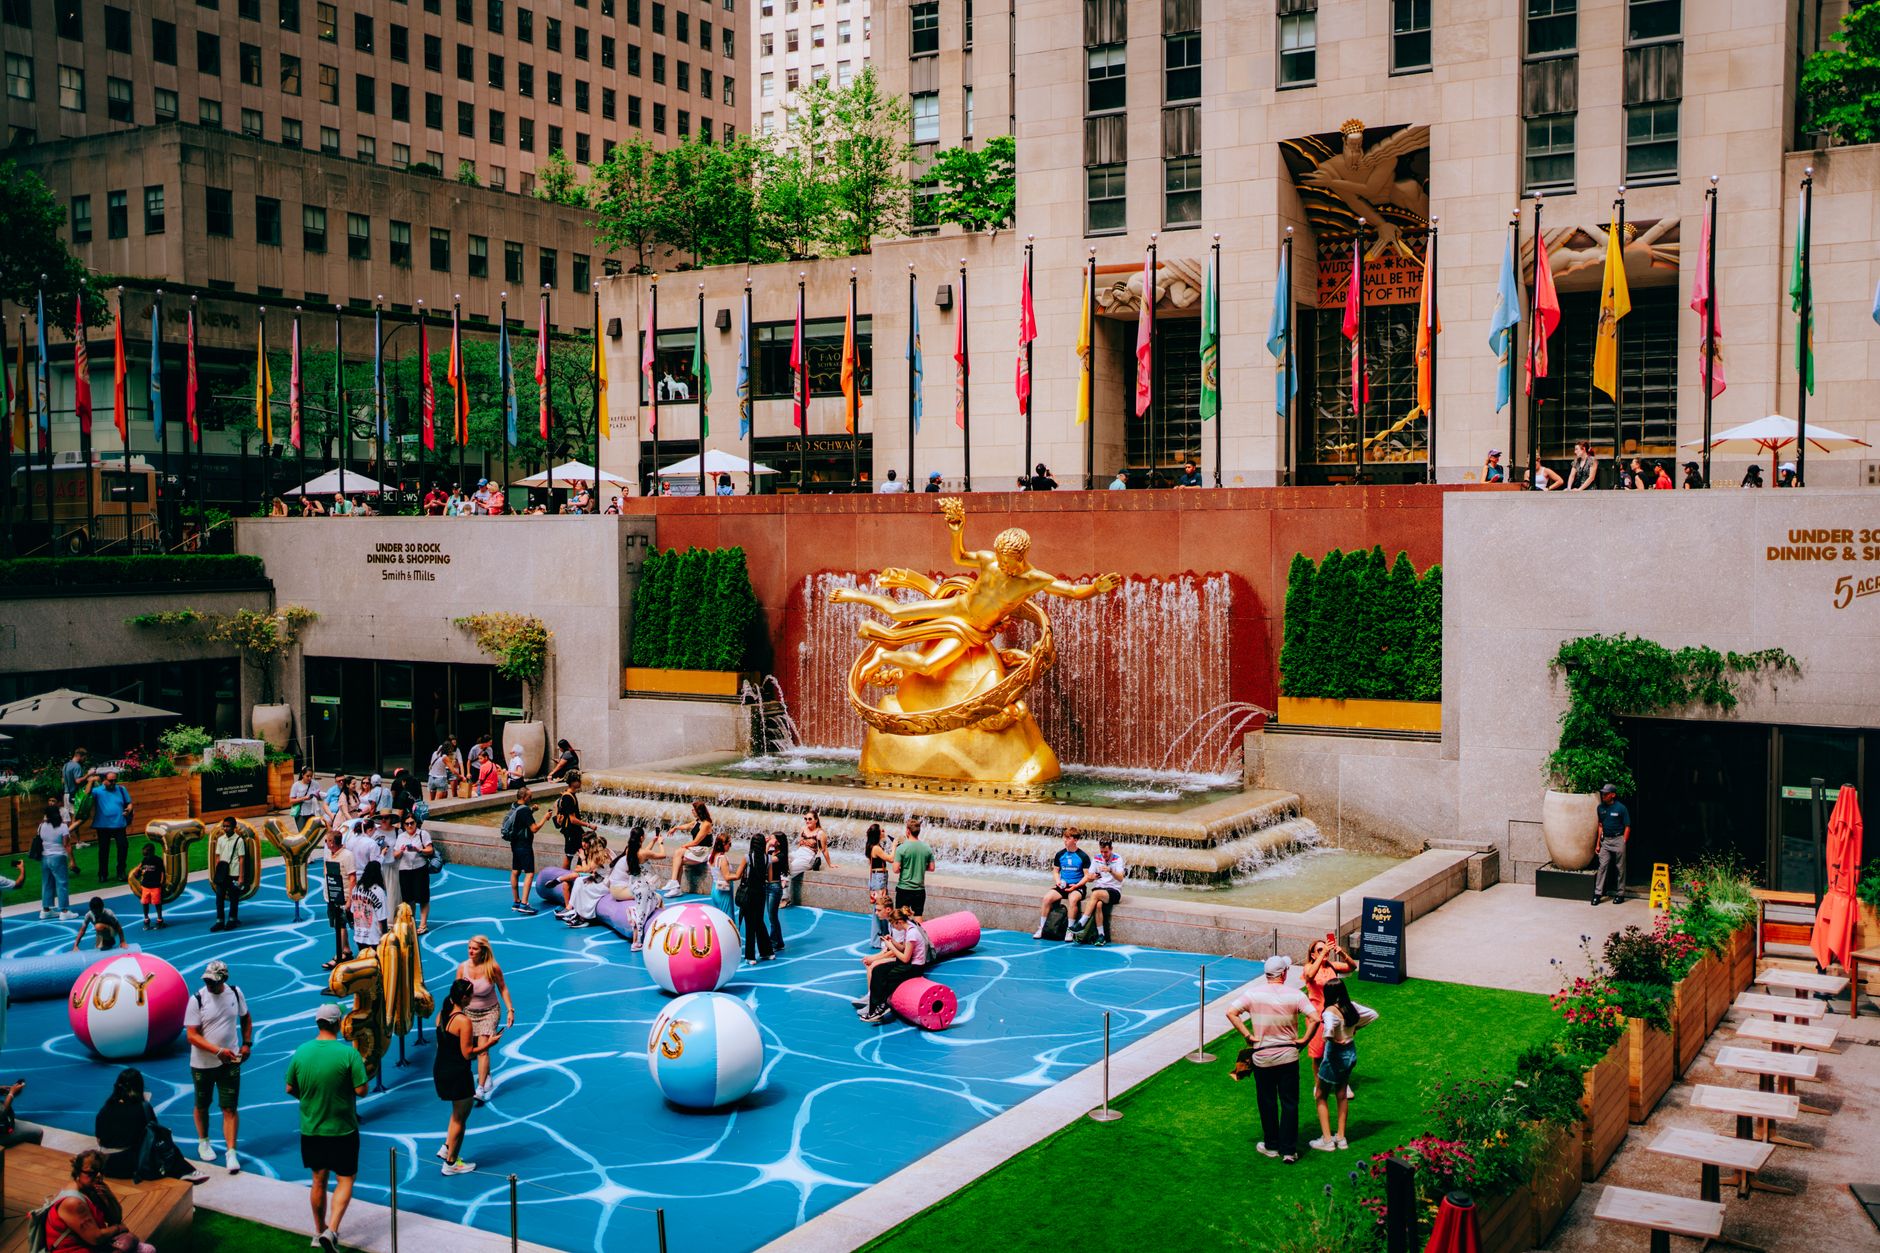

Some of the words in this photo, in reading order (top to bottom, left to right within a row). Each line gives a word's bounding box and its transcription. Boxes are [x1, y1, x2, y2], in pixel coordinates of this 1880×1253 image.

[1369, 262, 1381, 271] AND
[1363, 273, 1387, 286] HALL
[1389, 272, 1402, 285] BE
[1406, 270, 1423, 283] THE
[1376, 288, 1393, 300] OF
[1396, 286, 1419, 299] THY
[201, 310, 240, 330] NEWS
[1788, 529, 1853, 544] UNDER
[375, 543, 403, 553] UNDER
[405, 543, 416, 553] 30
[417, 543, 441, 553] ROCK
[1766, 546, 1838, 561] DINING
[1842, 546, 1857, 561] &
[367, 554, 396, 564] DINING
[398, 554, 404, 564] &
[406, 554, 451, 564] SHOPPING
[382, 569, 406, 581] Smith
[413, 569, 436, 581] Mills
[1833, 575, 1854, 610] 5
[648, 919, 712, 959] YOU
[71, 971, 155, 1011] JOY
[650, 1012, 694, 1060] US
